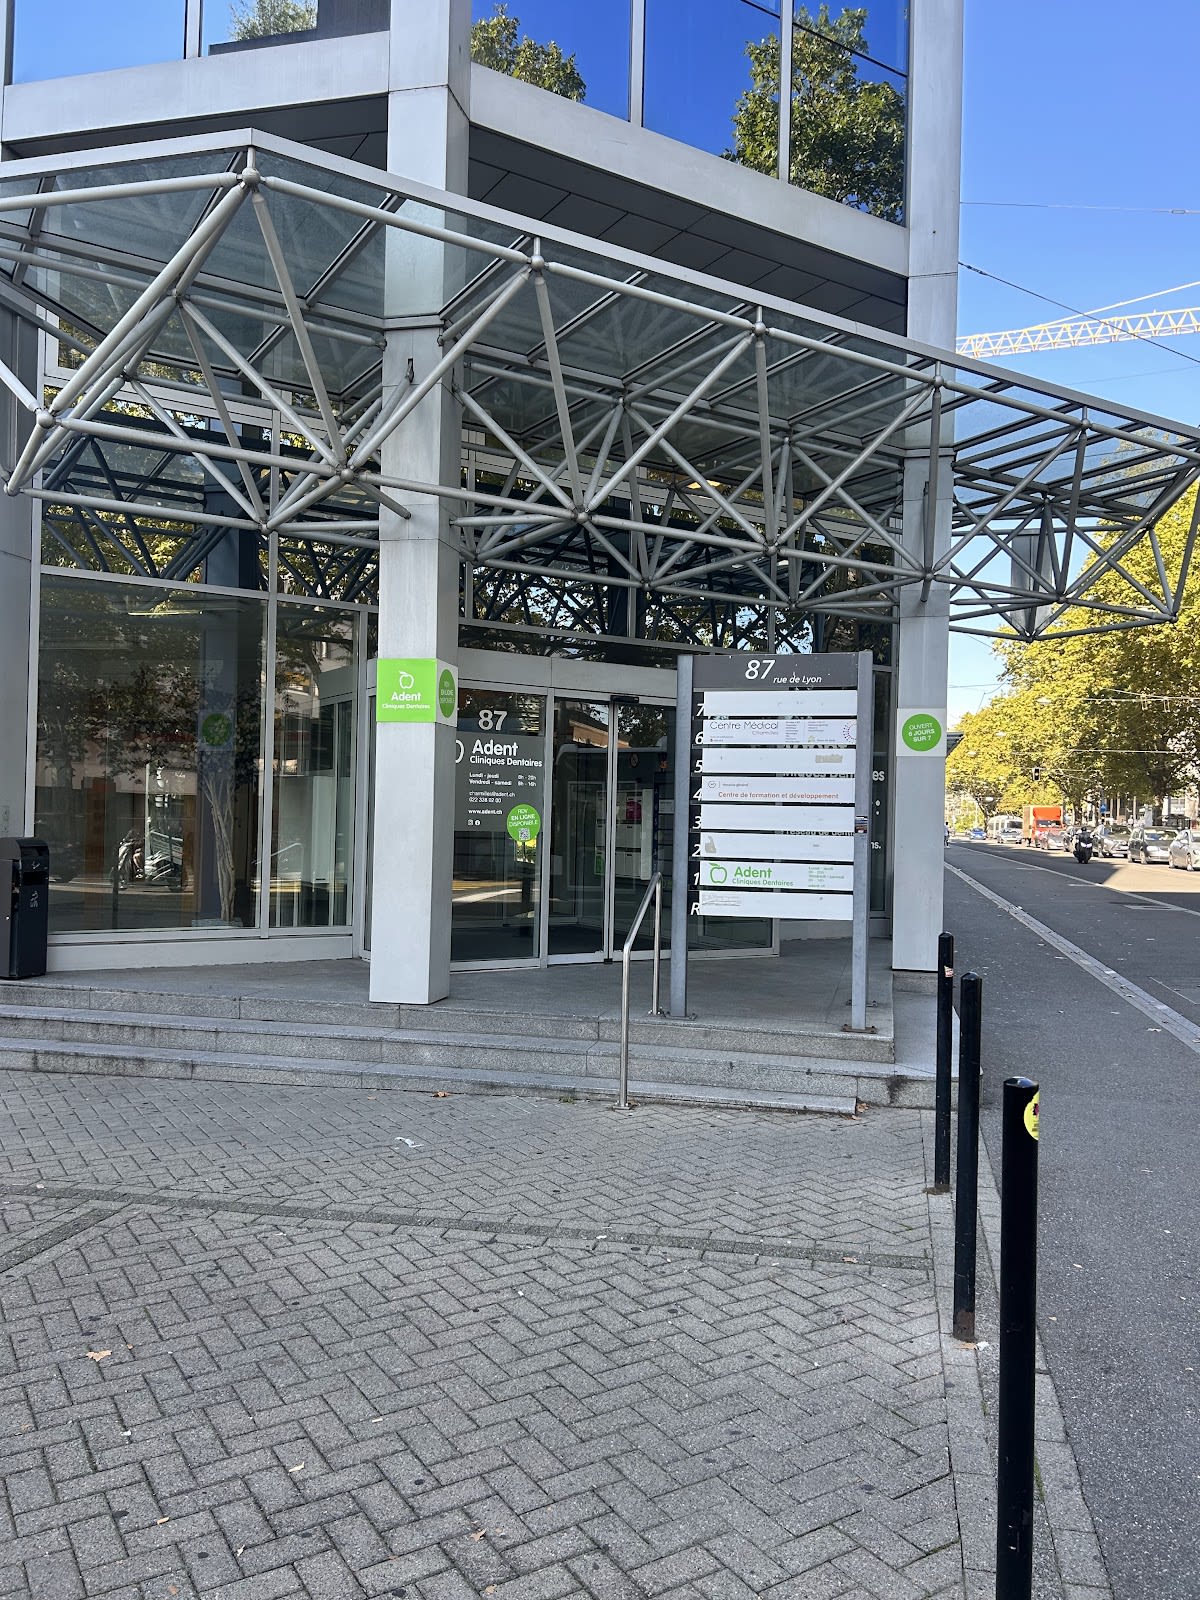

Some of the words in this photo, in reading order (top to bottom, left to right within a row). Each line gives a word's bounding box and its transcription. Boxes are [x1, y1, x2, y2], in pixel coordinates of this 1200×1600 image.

[745, 660, 775, 680] 87
[790, 675, 800, 684] de
[802, 676, 822, 684] Lyon
[391, 692, 421, 701] Adent
[478, 710, 508, 731] 87
[710, 721, 741, 730] Centre
[744, 721, 778, 729] Médical
[695, 732, 703, 744] 6
[472, 739, 518, 756] Adent
[470, 756, 505, 766] Cliniques
[507, 758, 542, 767] Dentaires
[692, 816, 701, 829] 3
[691, 844, 700, 857] 2
[734, 866, 772, 878] Adent
[693, 872, 700, 885] 1
[762, 879, 794, 887] Dentaires
[690, 903, 700, 915] R
